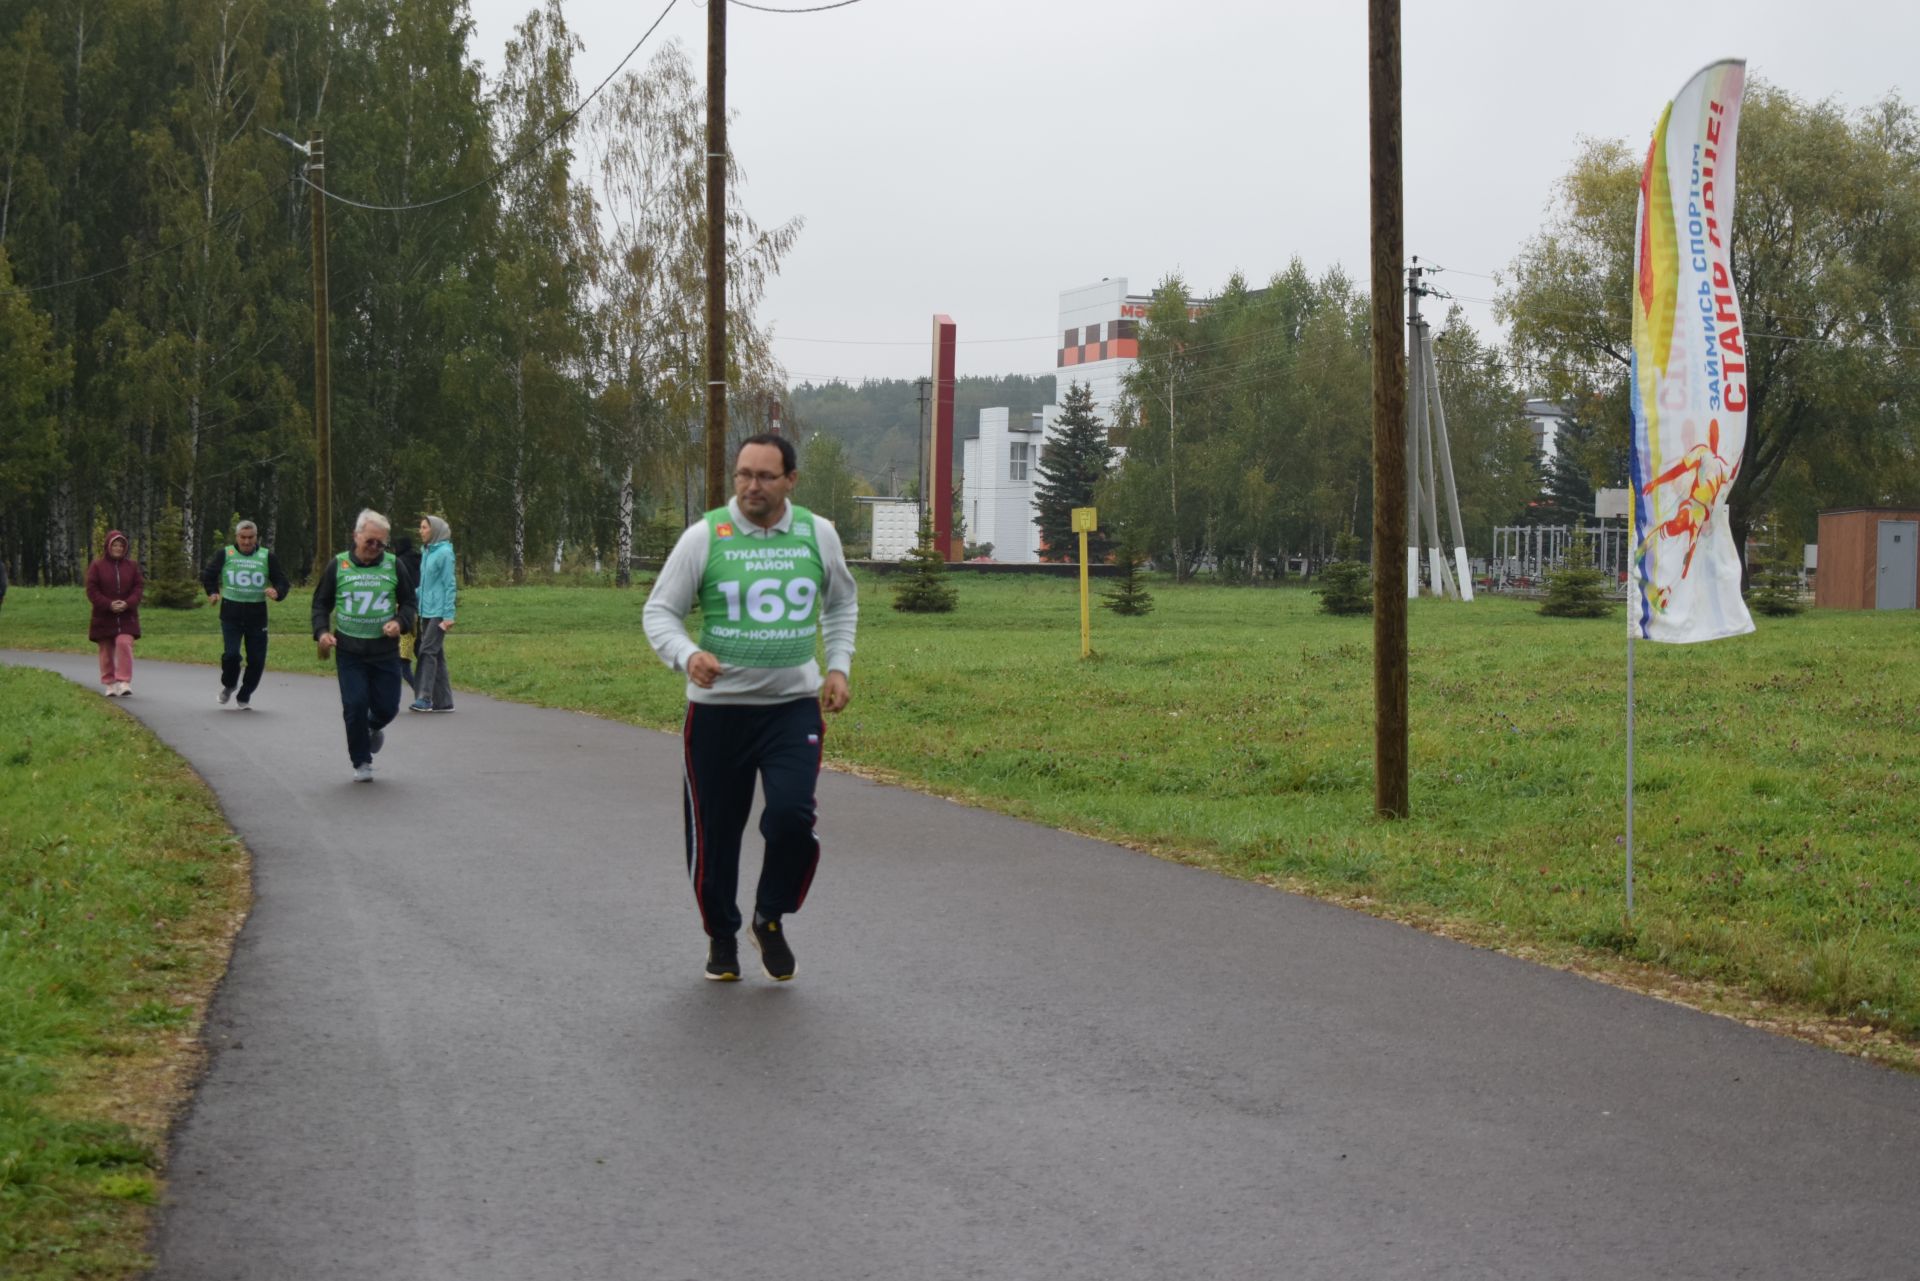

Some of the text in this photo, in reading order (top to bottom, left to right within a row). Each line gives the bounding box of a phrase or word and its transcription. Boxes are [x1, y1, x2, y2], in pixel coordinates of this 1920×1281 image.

[1688, 144, 1720, 411] ЗАЙМИСЬ СПОРТОМ
[1713, 262, 1746, 412] СТАНЬ
[724, 545, 811, 560] ТУКАЕВСКИЙ
[745, 559, 794, 572] РАЙОН
[227, 569, 265, 587] 160
[342, 592, 391, 615] 174
[717, 577, 817, 623] 169
